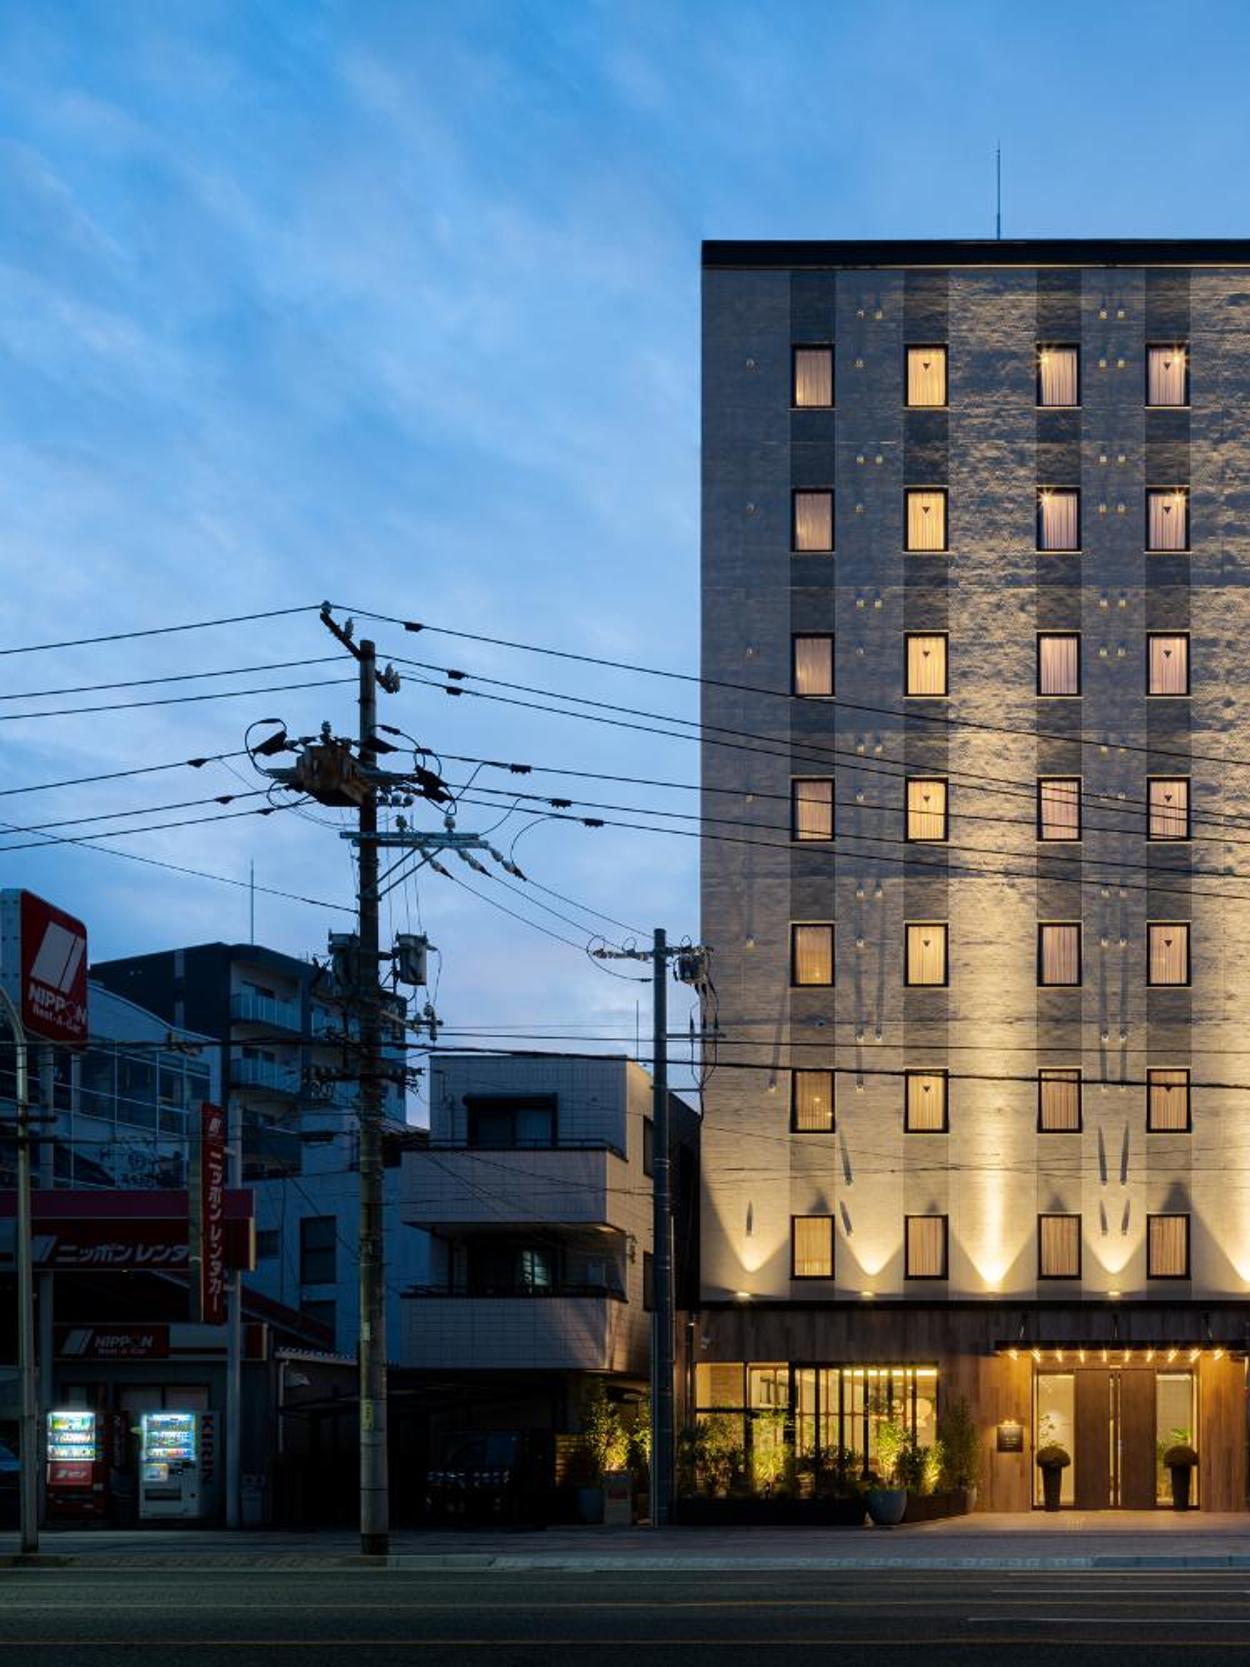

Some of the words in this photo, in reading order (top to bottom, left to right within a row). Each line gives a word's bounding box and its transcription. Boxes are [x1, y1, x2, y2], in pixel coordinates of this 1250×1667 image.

[28, 982, 87, 1025] NIPPON
[208, 1150, 223, 1312] ニッポンレンタカー
